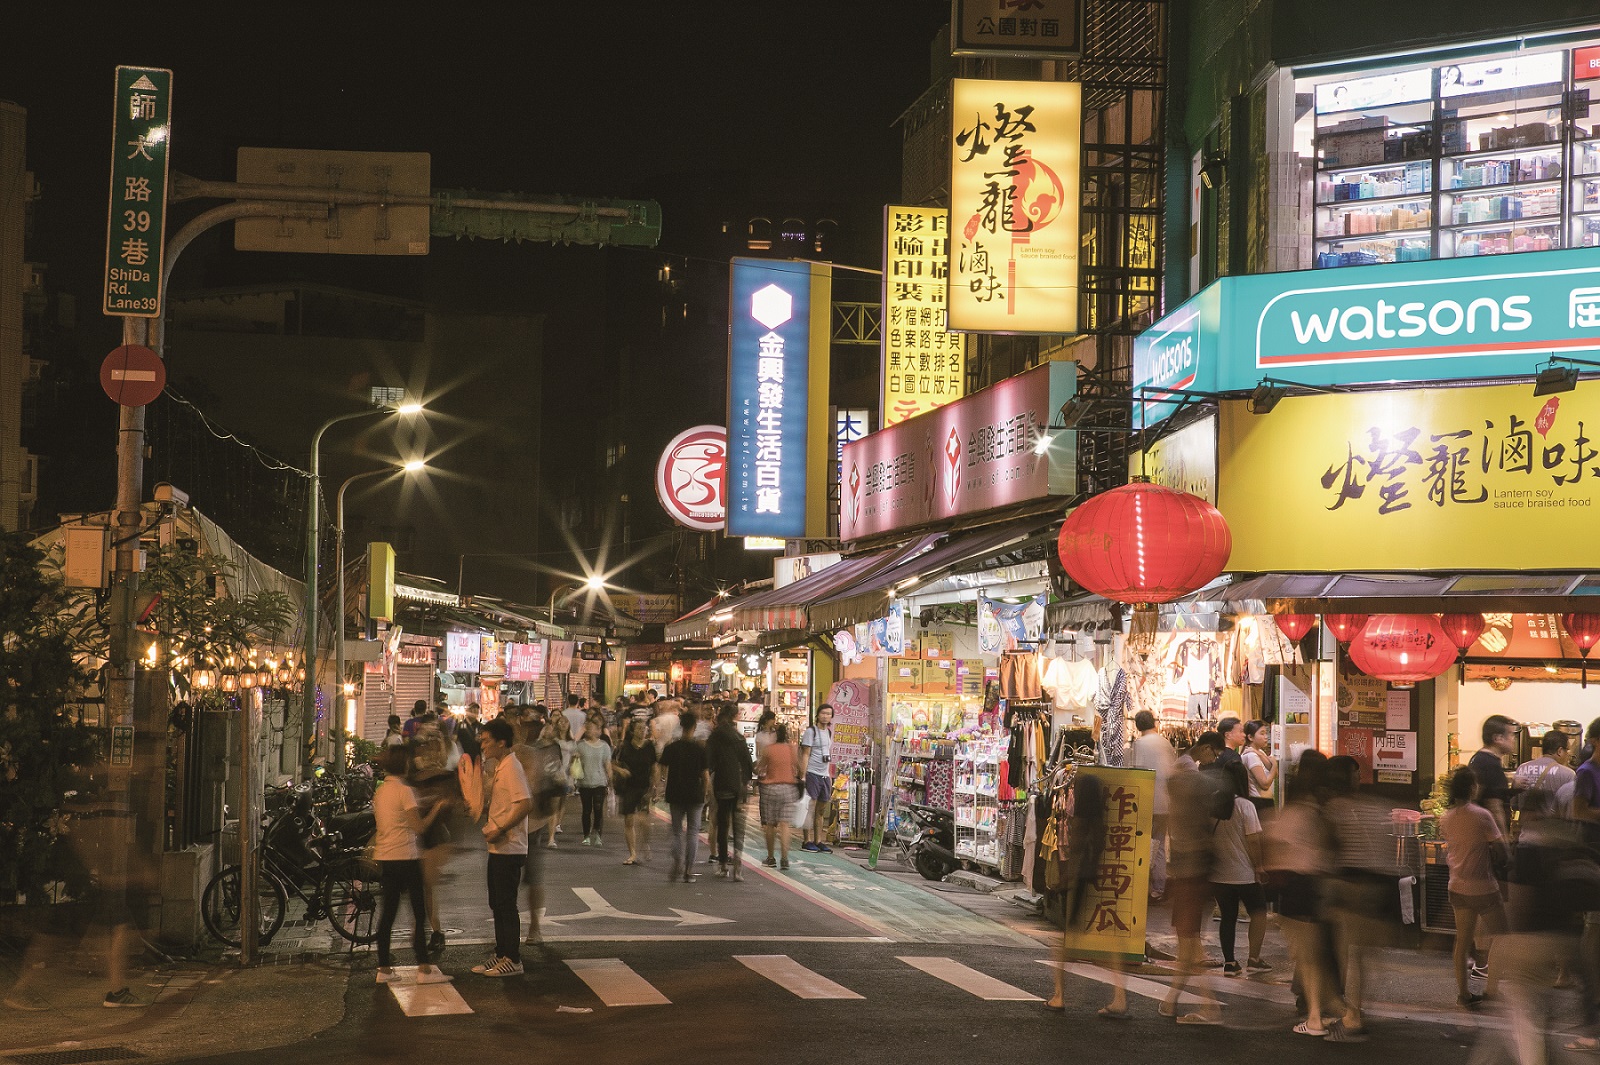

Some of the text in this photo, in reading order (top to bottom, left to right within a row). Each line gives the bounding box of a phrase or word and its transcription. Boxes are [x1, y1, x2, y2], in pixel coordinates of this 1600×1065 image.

[977, 16, 1059, 37] 公園對面
[110, 268, 150, 283] ShiDa
[109, 282, 132, 295] Rd.
[108, 296, 157, 311] Lane39
[1290, 294, 1533, 344] watsons
[890, 306, 902, 393] 彩色黑白
[904, 306, 917, 394] 檔案大圖
[919, 307, 931, 395] 網路數位
[1151, 335, 1192, 387] watsons
[755, 331, 785, 515] 金興發生活百貨
[1493, 489, 1554, 499] Lantern soy
[1493, 497, 1591, 509] sauce braised food
[1375, 734, 1407, 749] 內用區
[1539, 765, 1559, 775] NW
